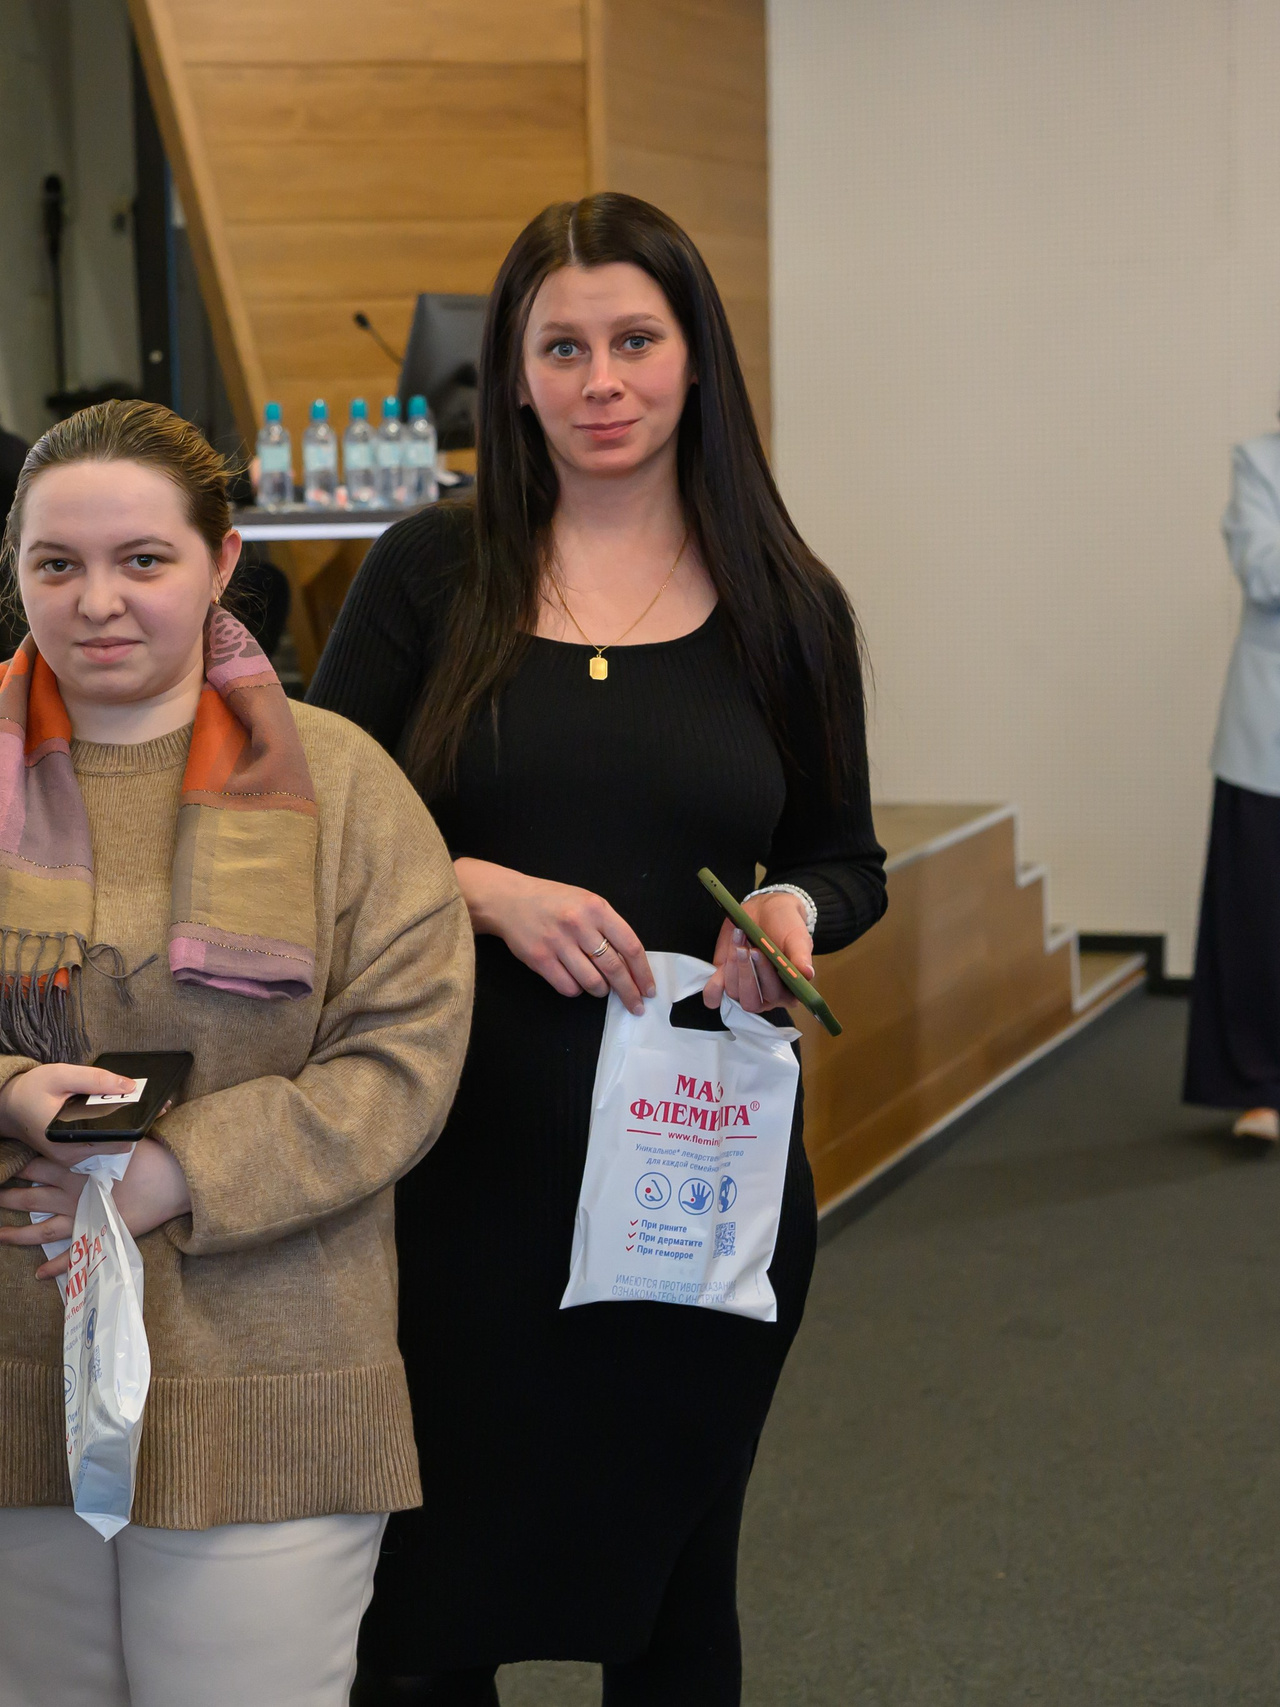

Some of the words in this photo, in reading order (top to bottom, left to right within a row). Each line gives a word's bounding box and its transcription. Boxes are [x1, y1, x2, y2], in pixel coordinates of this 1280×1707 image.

[646, 1157, 661, 1165] для
[662, 1159, 688, 1168] каждой
[641, 1219, 657, 1230] При
[659, 1223, 688, 1234] рините
[639, 1231, 655, 1242] При
[658, 1236, 703, 1248] дерматите
[637, 1244, 653, 1255] При
[655, 1248, 694, 1260] геморрое
[616, 1273, 658, 1289] ИМЕЮТСЯ
